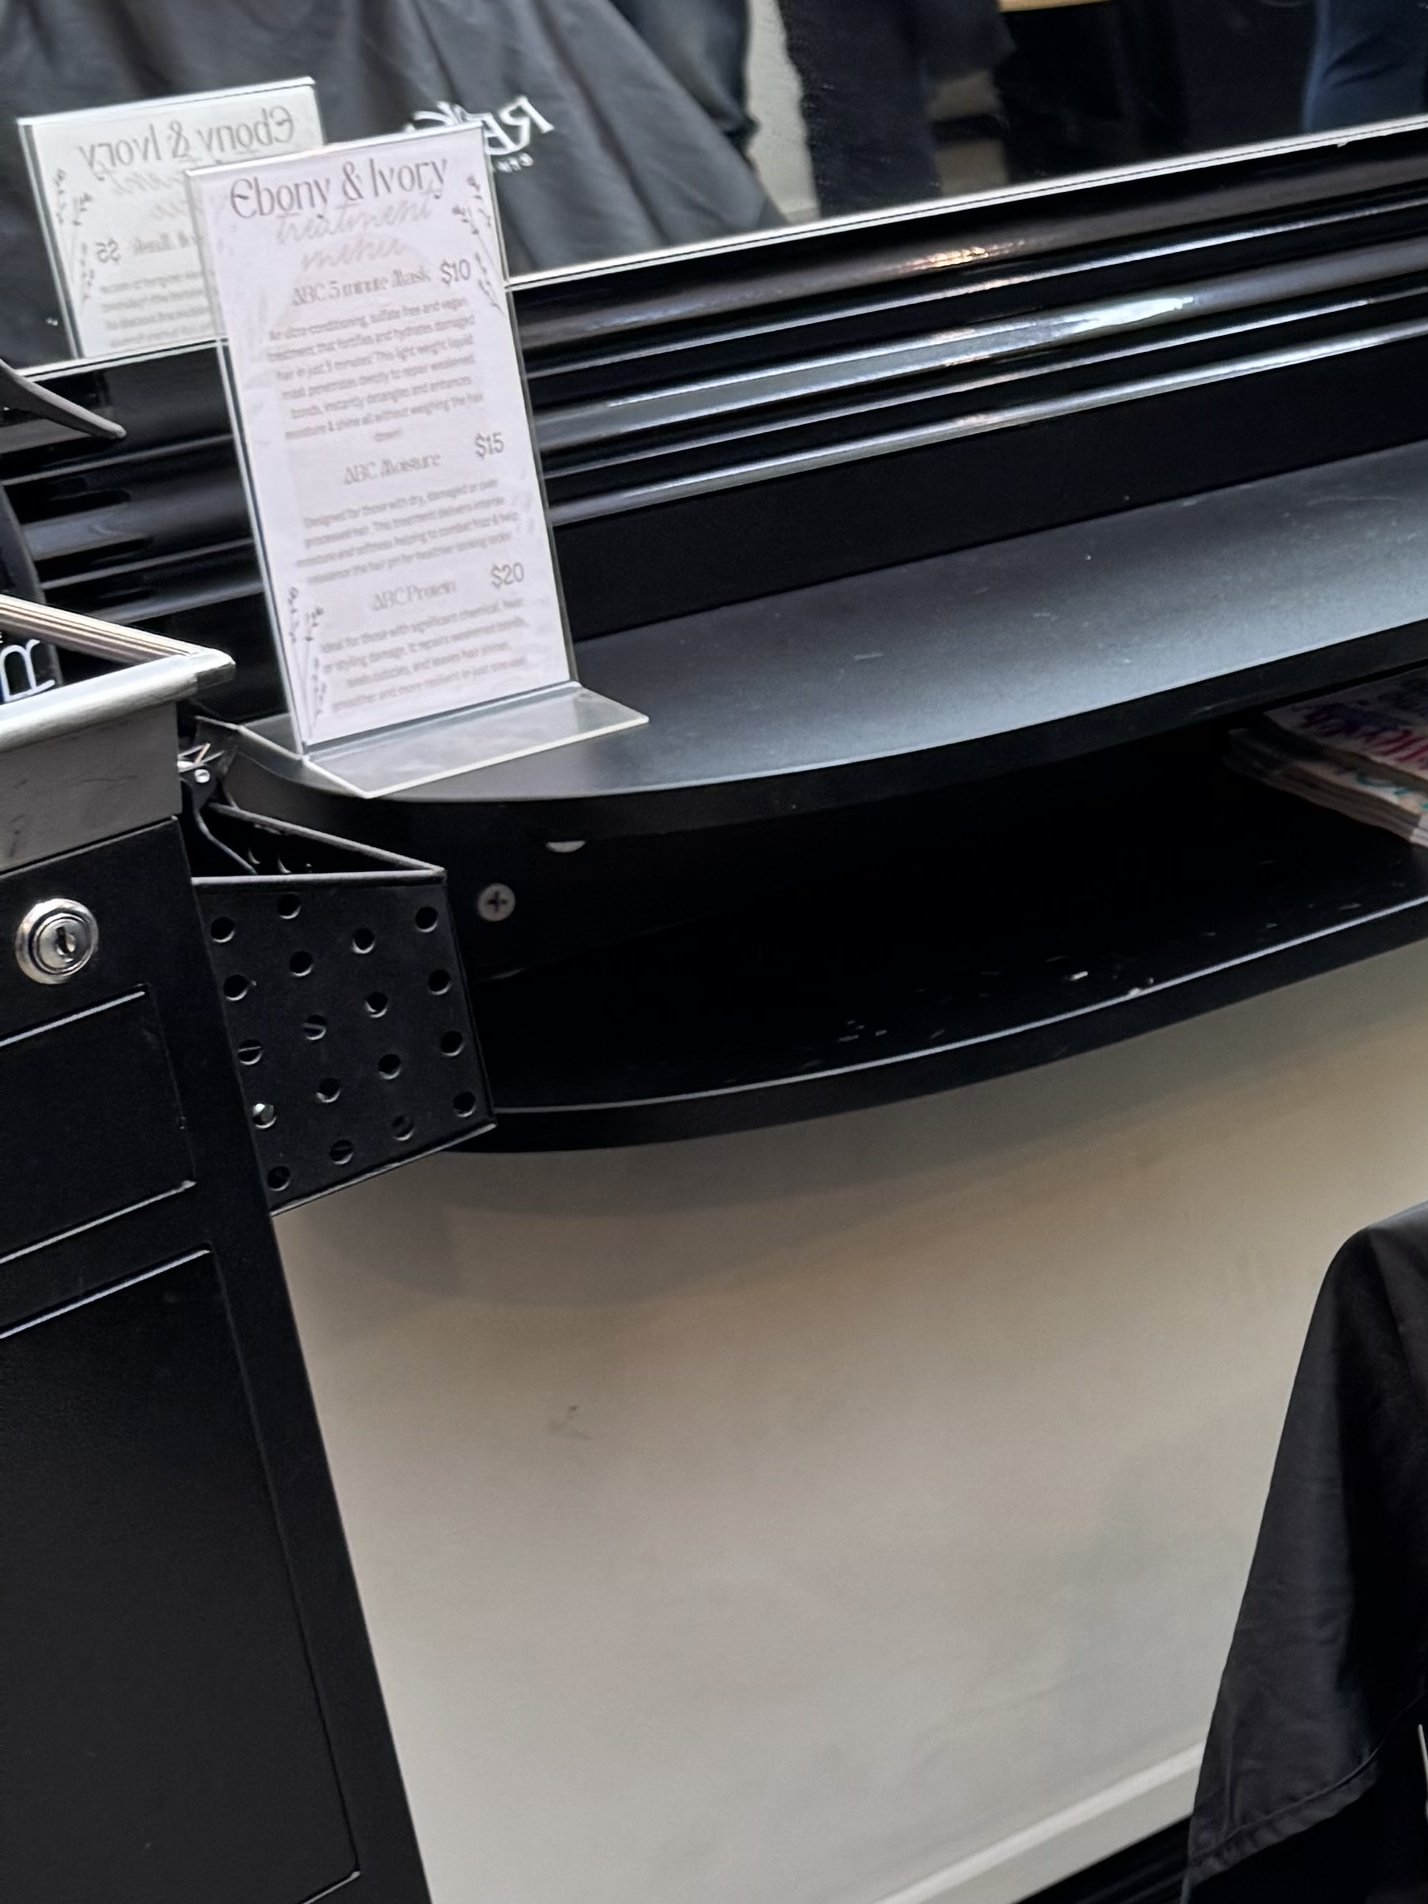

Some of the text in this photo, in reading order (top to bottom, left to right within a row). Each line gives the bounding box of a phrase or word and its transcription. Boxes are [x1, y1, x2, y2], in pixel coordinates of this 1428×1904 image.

[229, 175, 331, 220] Ebony
[341, 160, 364, 201] &
[369, 157, 448, 200] Ivory
[328, 280, 341, 299] 5
[439, 259, 471, 287] $10
[475, 432, 505, 459] $15
[490, 562, 525, 590] $20
